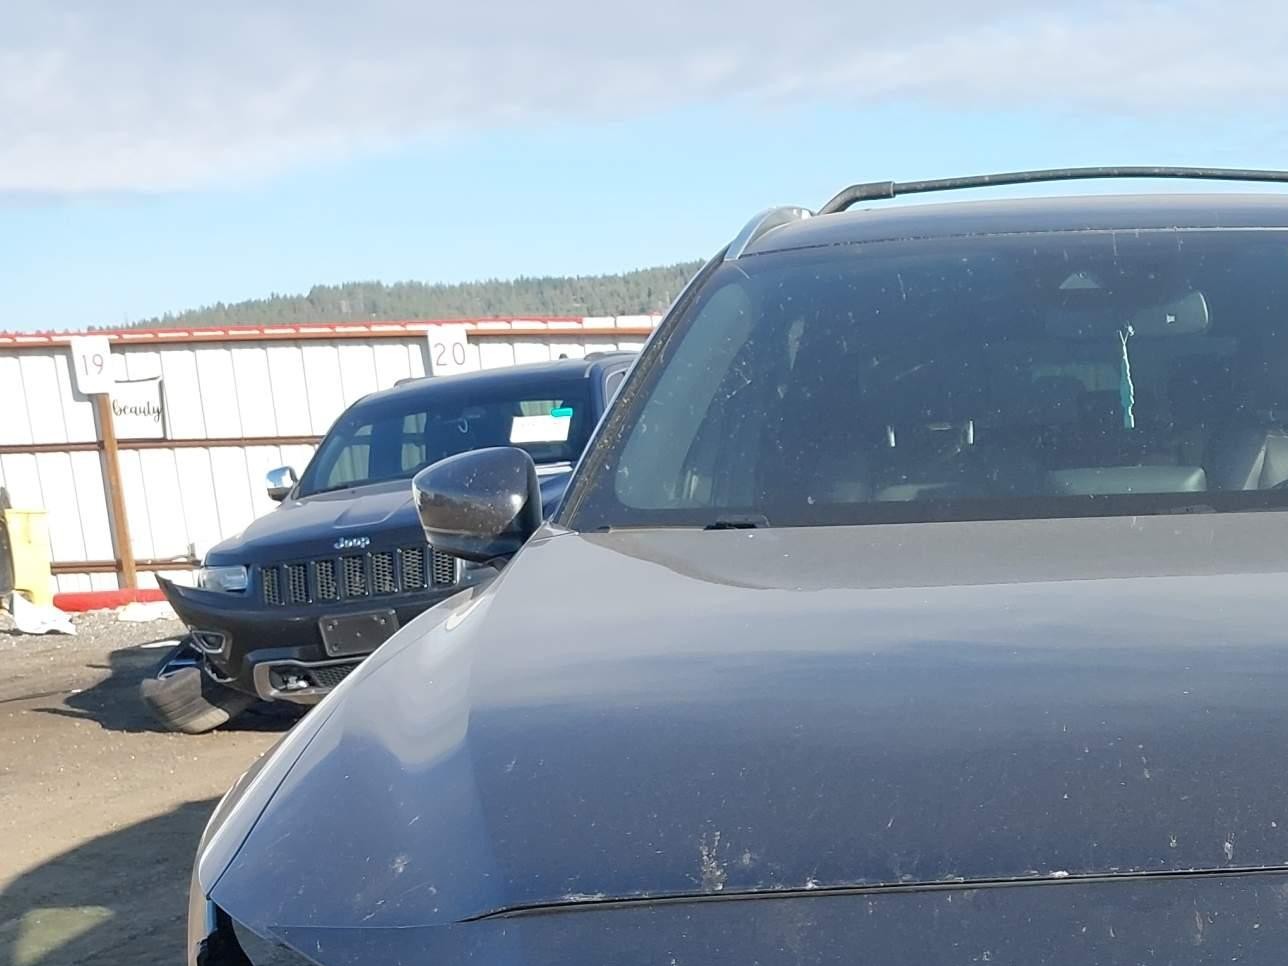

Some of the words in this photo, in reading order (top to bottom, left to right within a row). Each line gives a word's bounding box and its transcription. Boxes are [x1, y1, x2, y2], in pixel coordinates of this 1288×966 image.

[82, 353, 104, 376] 19
[433, 342, 466, 367] 20
[112, 399, 162, 424] beauty
